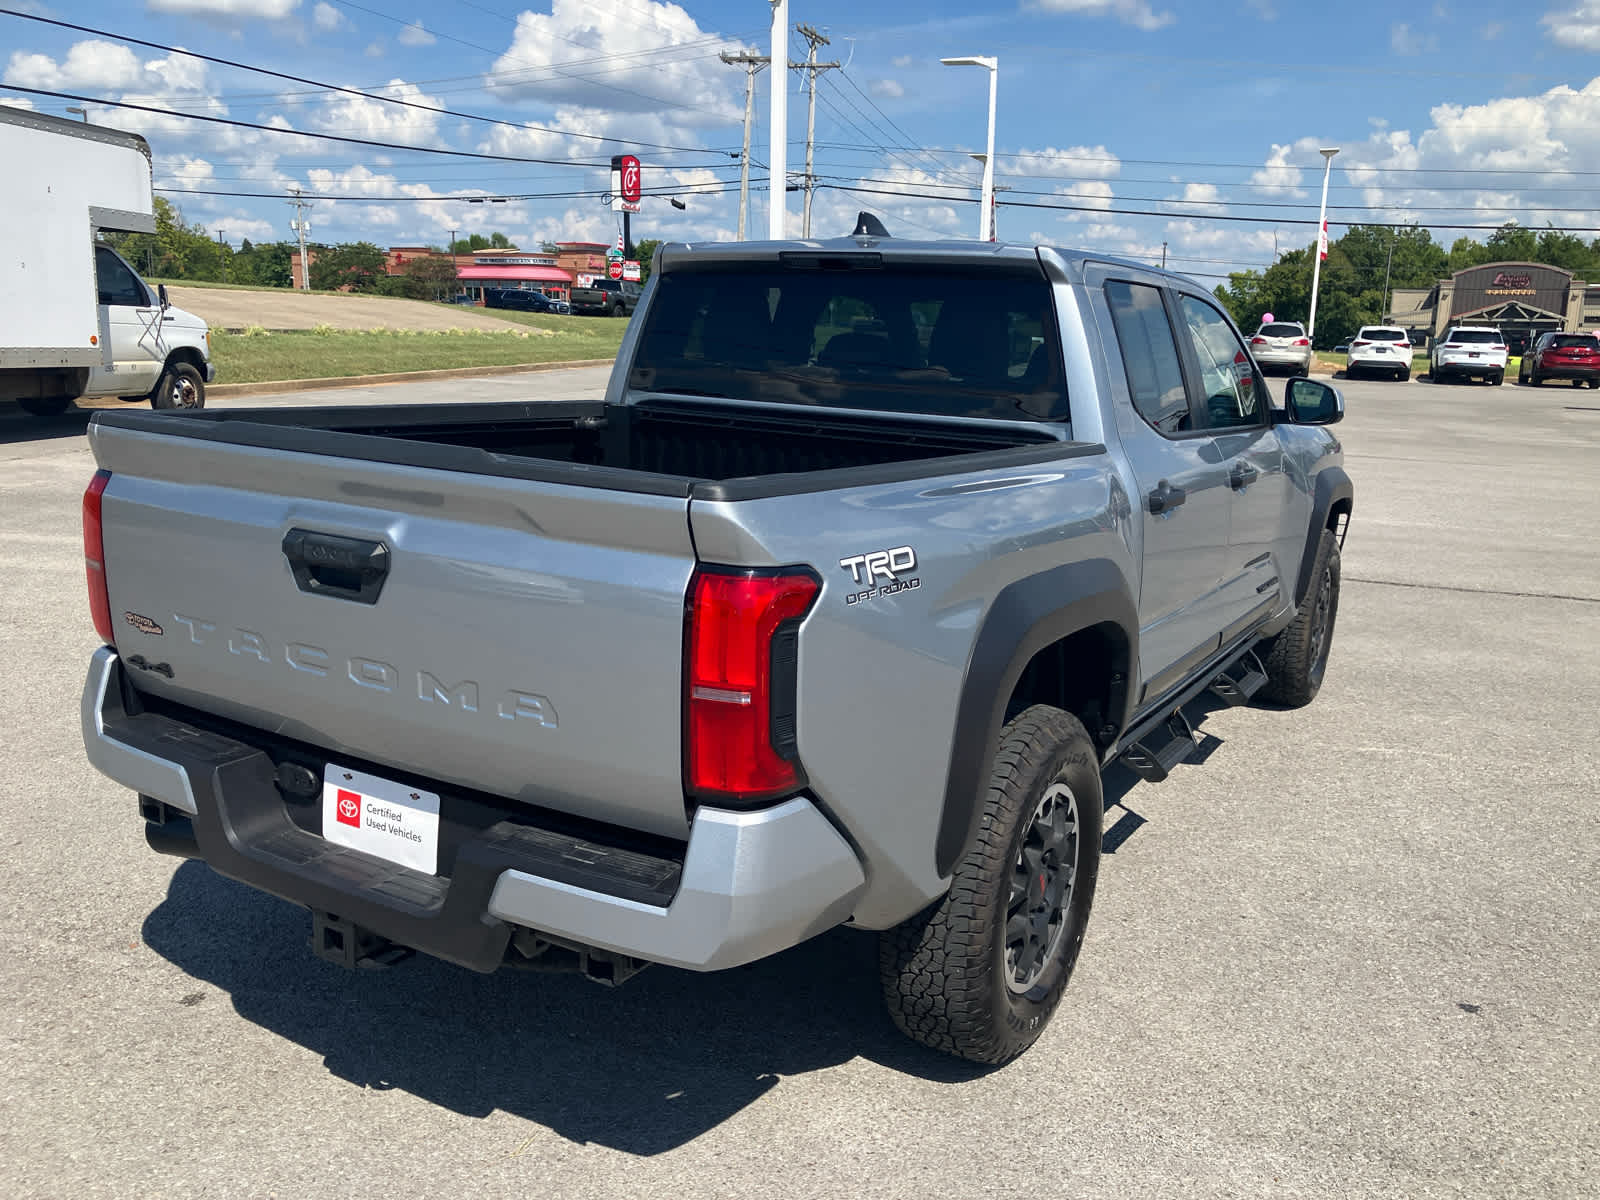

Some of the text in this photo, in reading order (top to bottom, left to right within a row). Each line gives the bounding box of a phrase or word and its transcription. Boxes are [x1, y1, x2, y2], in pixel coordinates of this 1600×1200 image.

[840, 546, 917, 585] TRD
[846, 577, 921, 606] OFF ROAD
[174, 613, 560, 729] TACOMA
[366, 803, 402, 822] Certified
[366, 817, 422, 843] Used Vehicles
